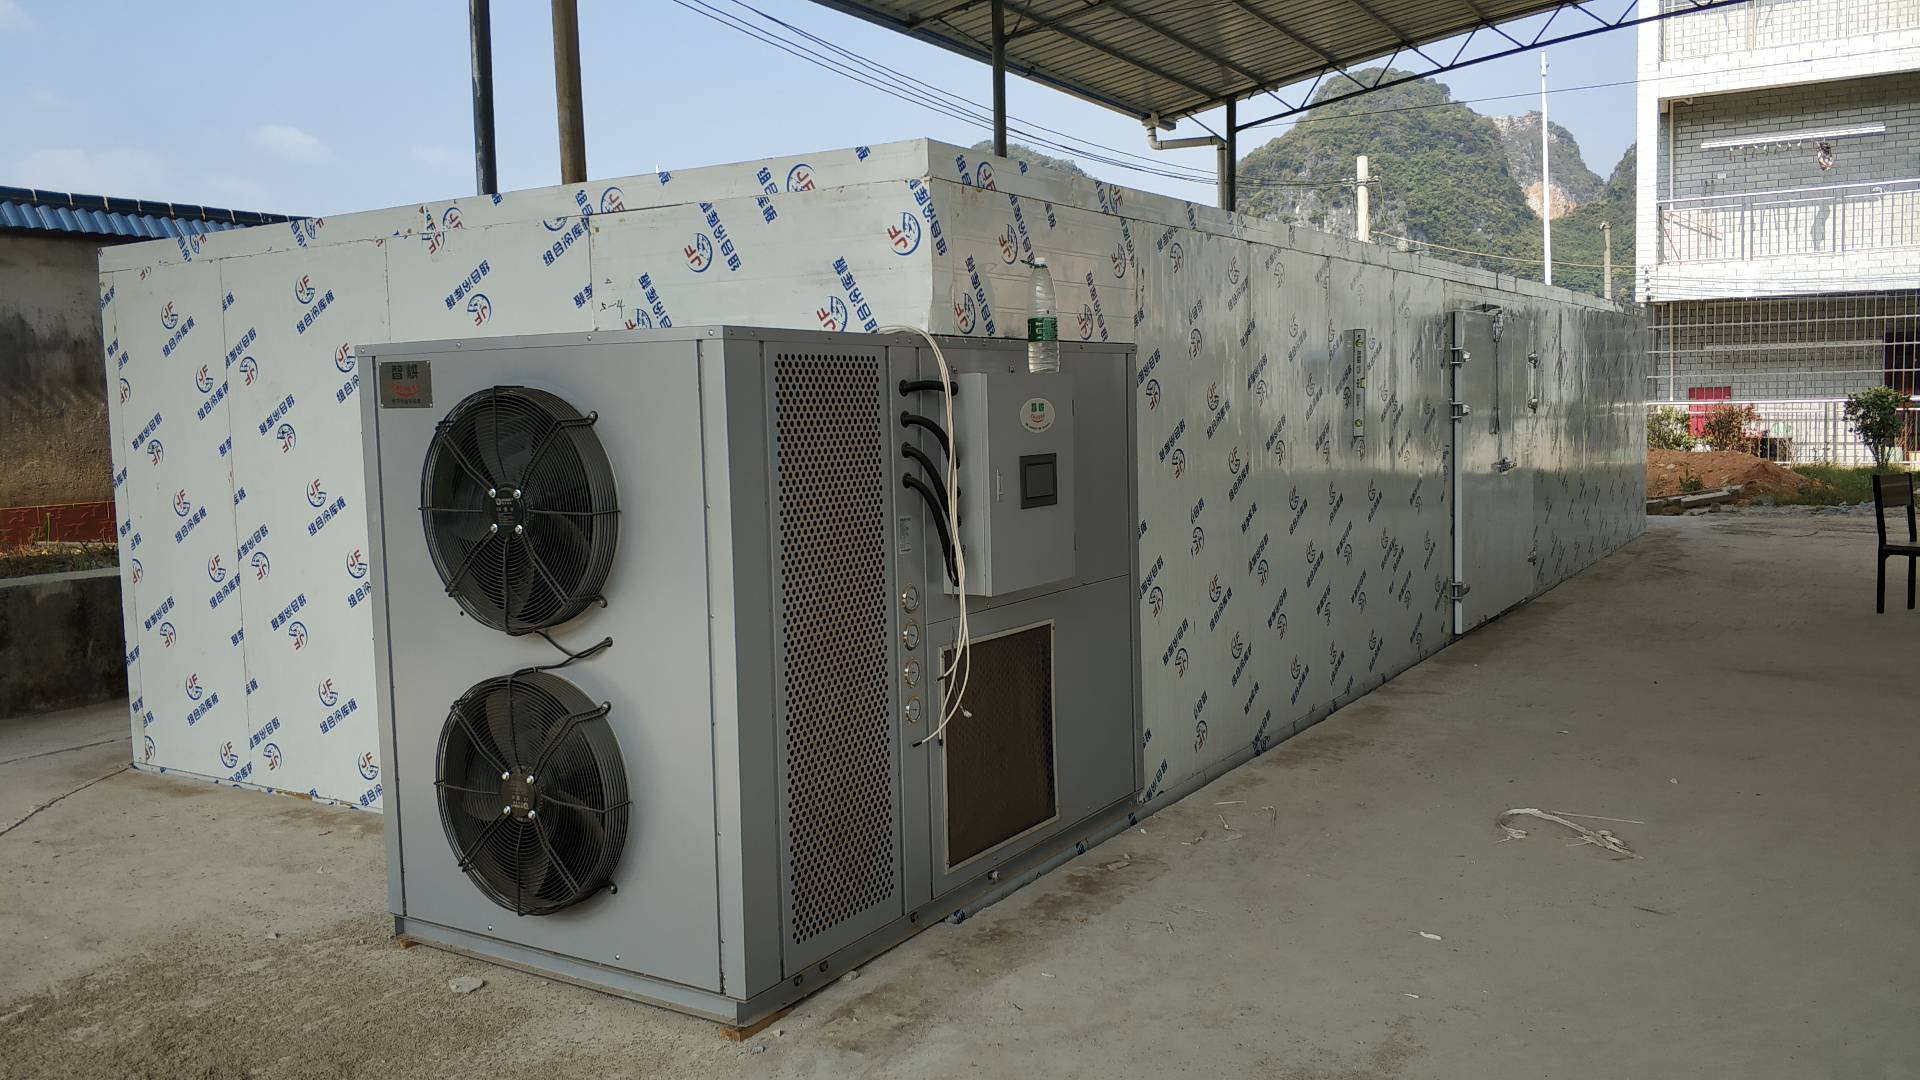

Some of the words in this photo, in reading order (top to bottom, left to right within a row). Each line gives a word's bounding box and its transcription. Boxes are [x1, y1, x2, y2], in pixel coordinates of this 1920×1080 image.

[887, 224, 909, 250] JF
[684, 244, 703, 267] JF
[298, 274, 311, 296] JF
[444, 259, 492, 311] 组合冷库板
[296, 289, 336, 336] 组合冷库板
[474, 304, 488, 327] JF
[816, 306, 837, 331] JF
[258, 393, 296, 437] 组合冷库板
[309, 478, 321, 497] JF
[307, 496, 347, 537] 组合冷库板
[349, 549, 361, 568] JF
[270, 592, 307, 631] 组合冷库板
[320, 678, 333, 697] JF
[319, 697, 358, 735] 组合冷库板
